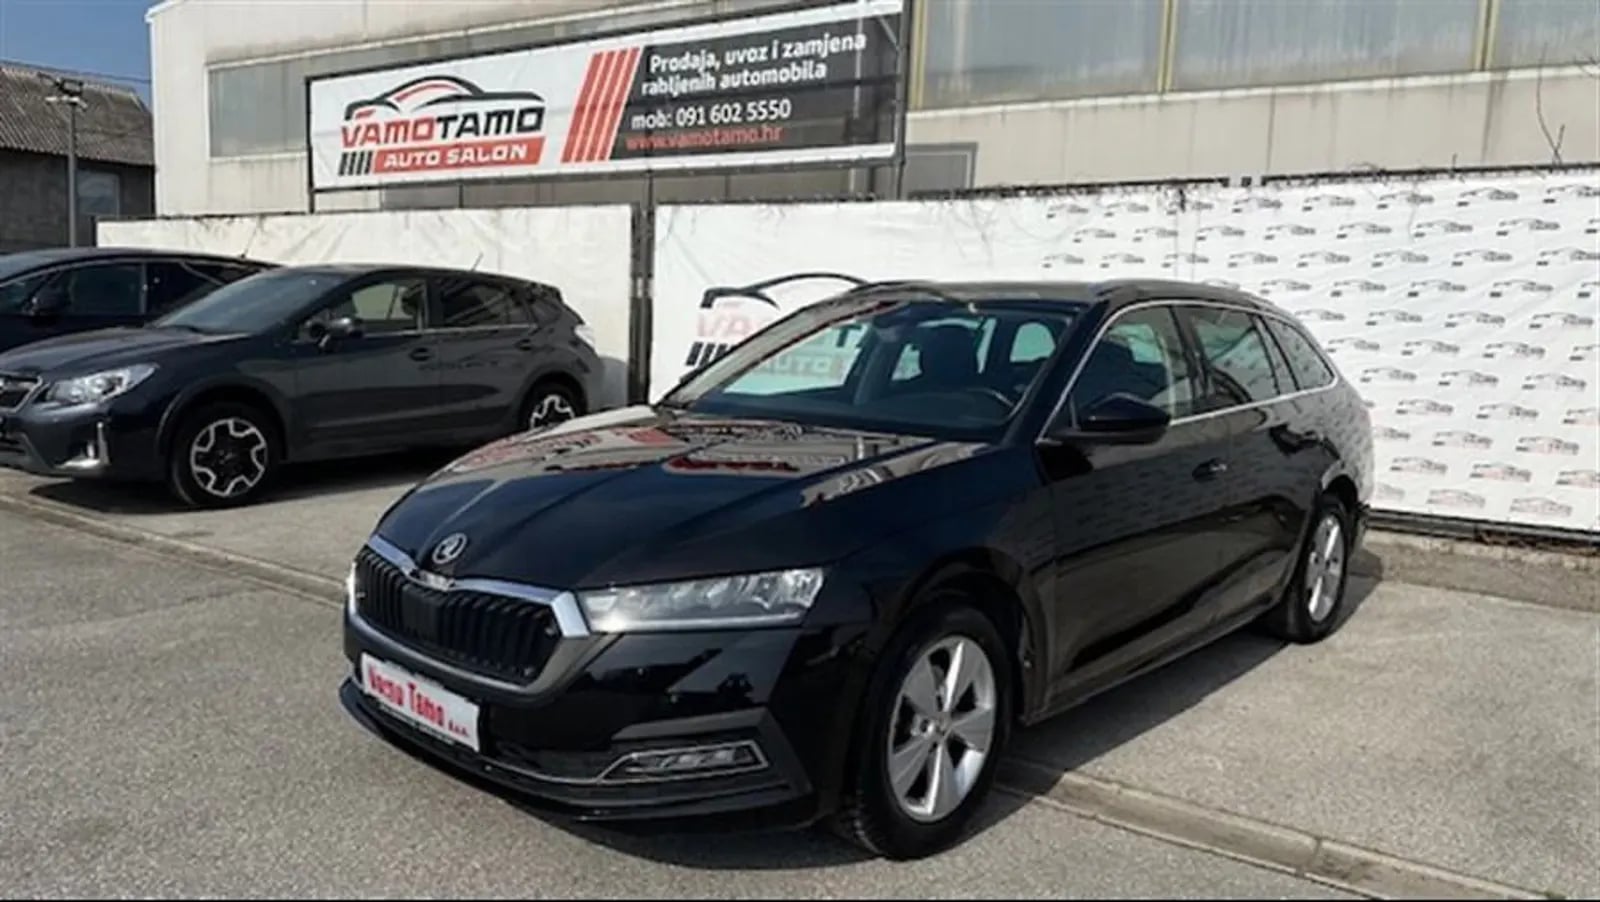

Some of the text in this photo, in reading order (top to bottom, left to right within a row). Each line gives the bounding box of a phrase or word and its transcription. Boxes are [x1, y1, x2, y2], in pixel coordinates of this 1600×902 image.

[650, 33, 867, 73] Prodaja, uvoz i zamjena
[641, 61, 827, 97] rabljenih automobila
[341, 107, 546, 148] VAMOTAMO
[631, 99, 792, 129] mob: 091 602 5550
[625, 125, 783, 152] www.vamotamo.hr
[384, 144, 527, 169] AUTO SALON
